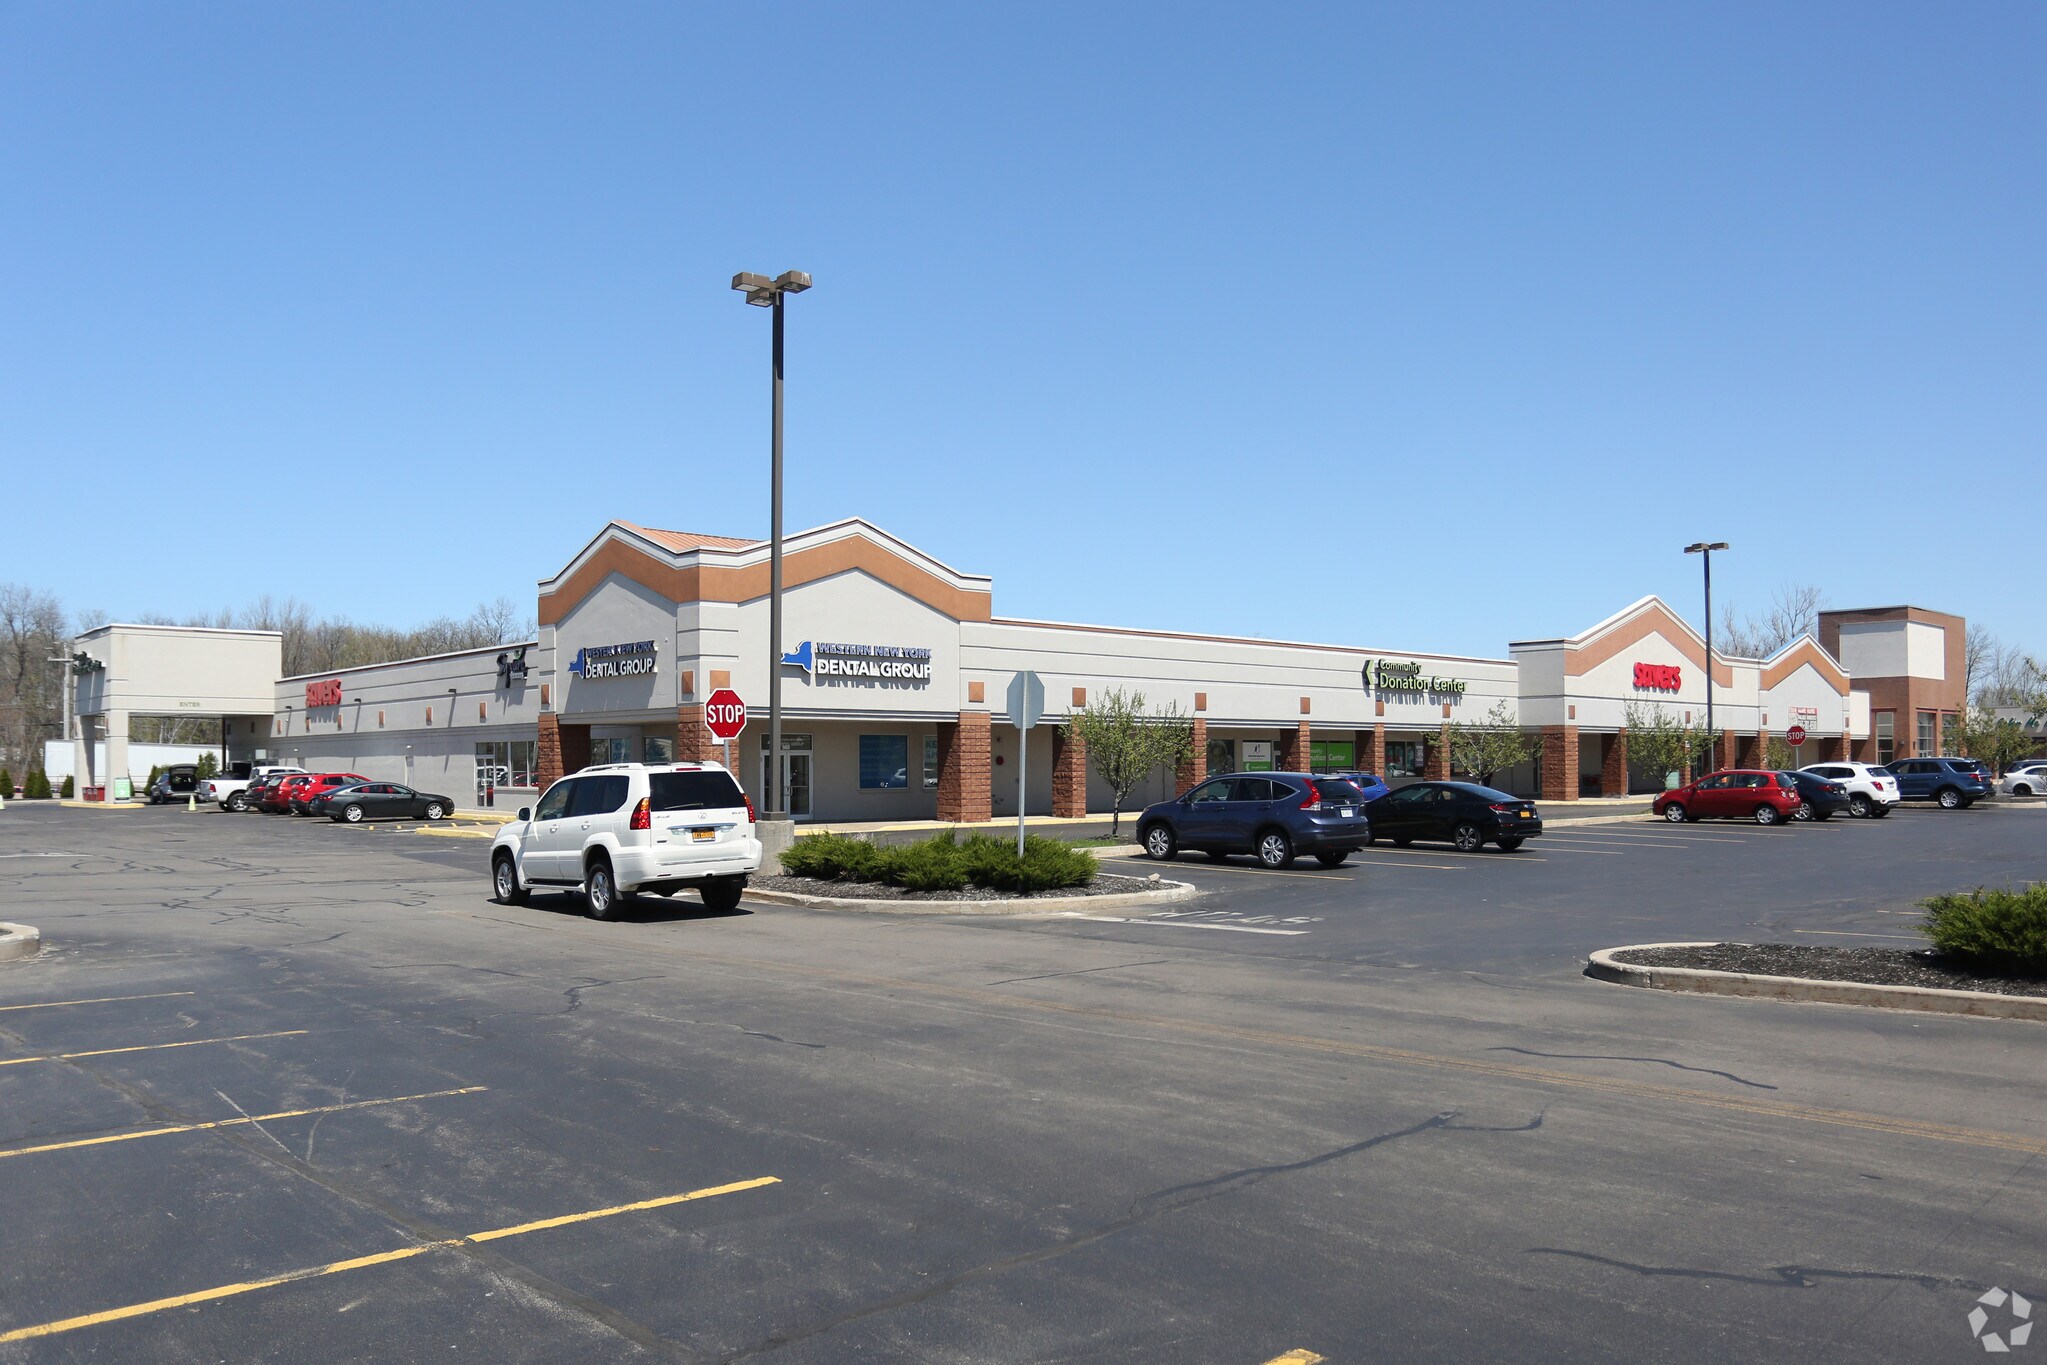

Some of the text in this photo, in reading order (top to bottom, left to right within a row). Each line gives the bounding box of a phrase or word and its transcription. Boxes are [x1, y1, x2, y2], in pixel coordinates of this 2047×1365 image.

[635, 640, 655, 653] YORK
[816, 642, 932, 659] WESTERN NEW YORK
[585, 658, 653, 679] DENTAL GROUP
[816, 658, 933, 679] DENTAL GROUP
[1379, 659, 1422, 675] Community
[1379, 672, 1468, 692] Donation Center
[707, 704, 744, 724] STOP
[1787, 731, 1805, 741] STOP
